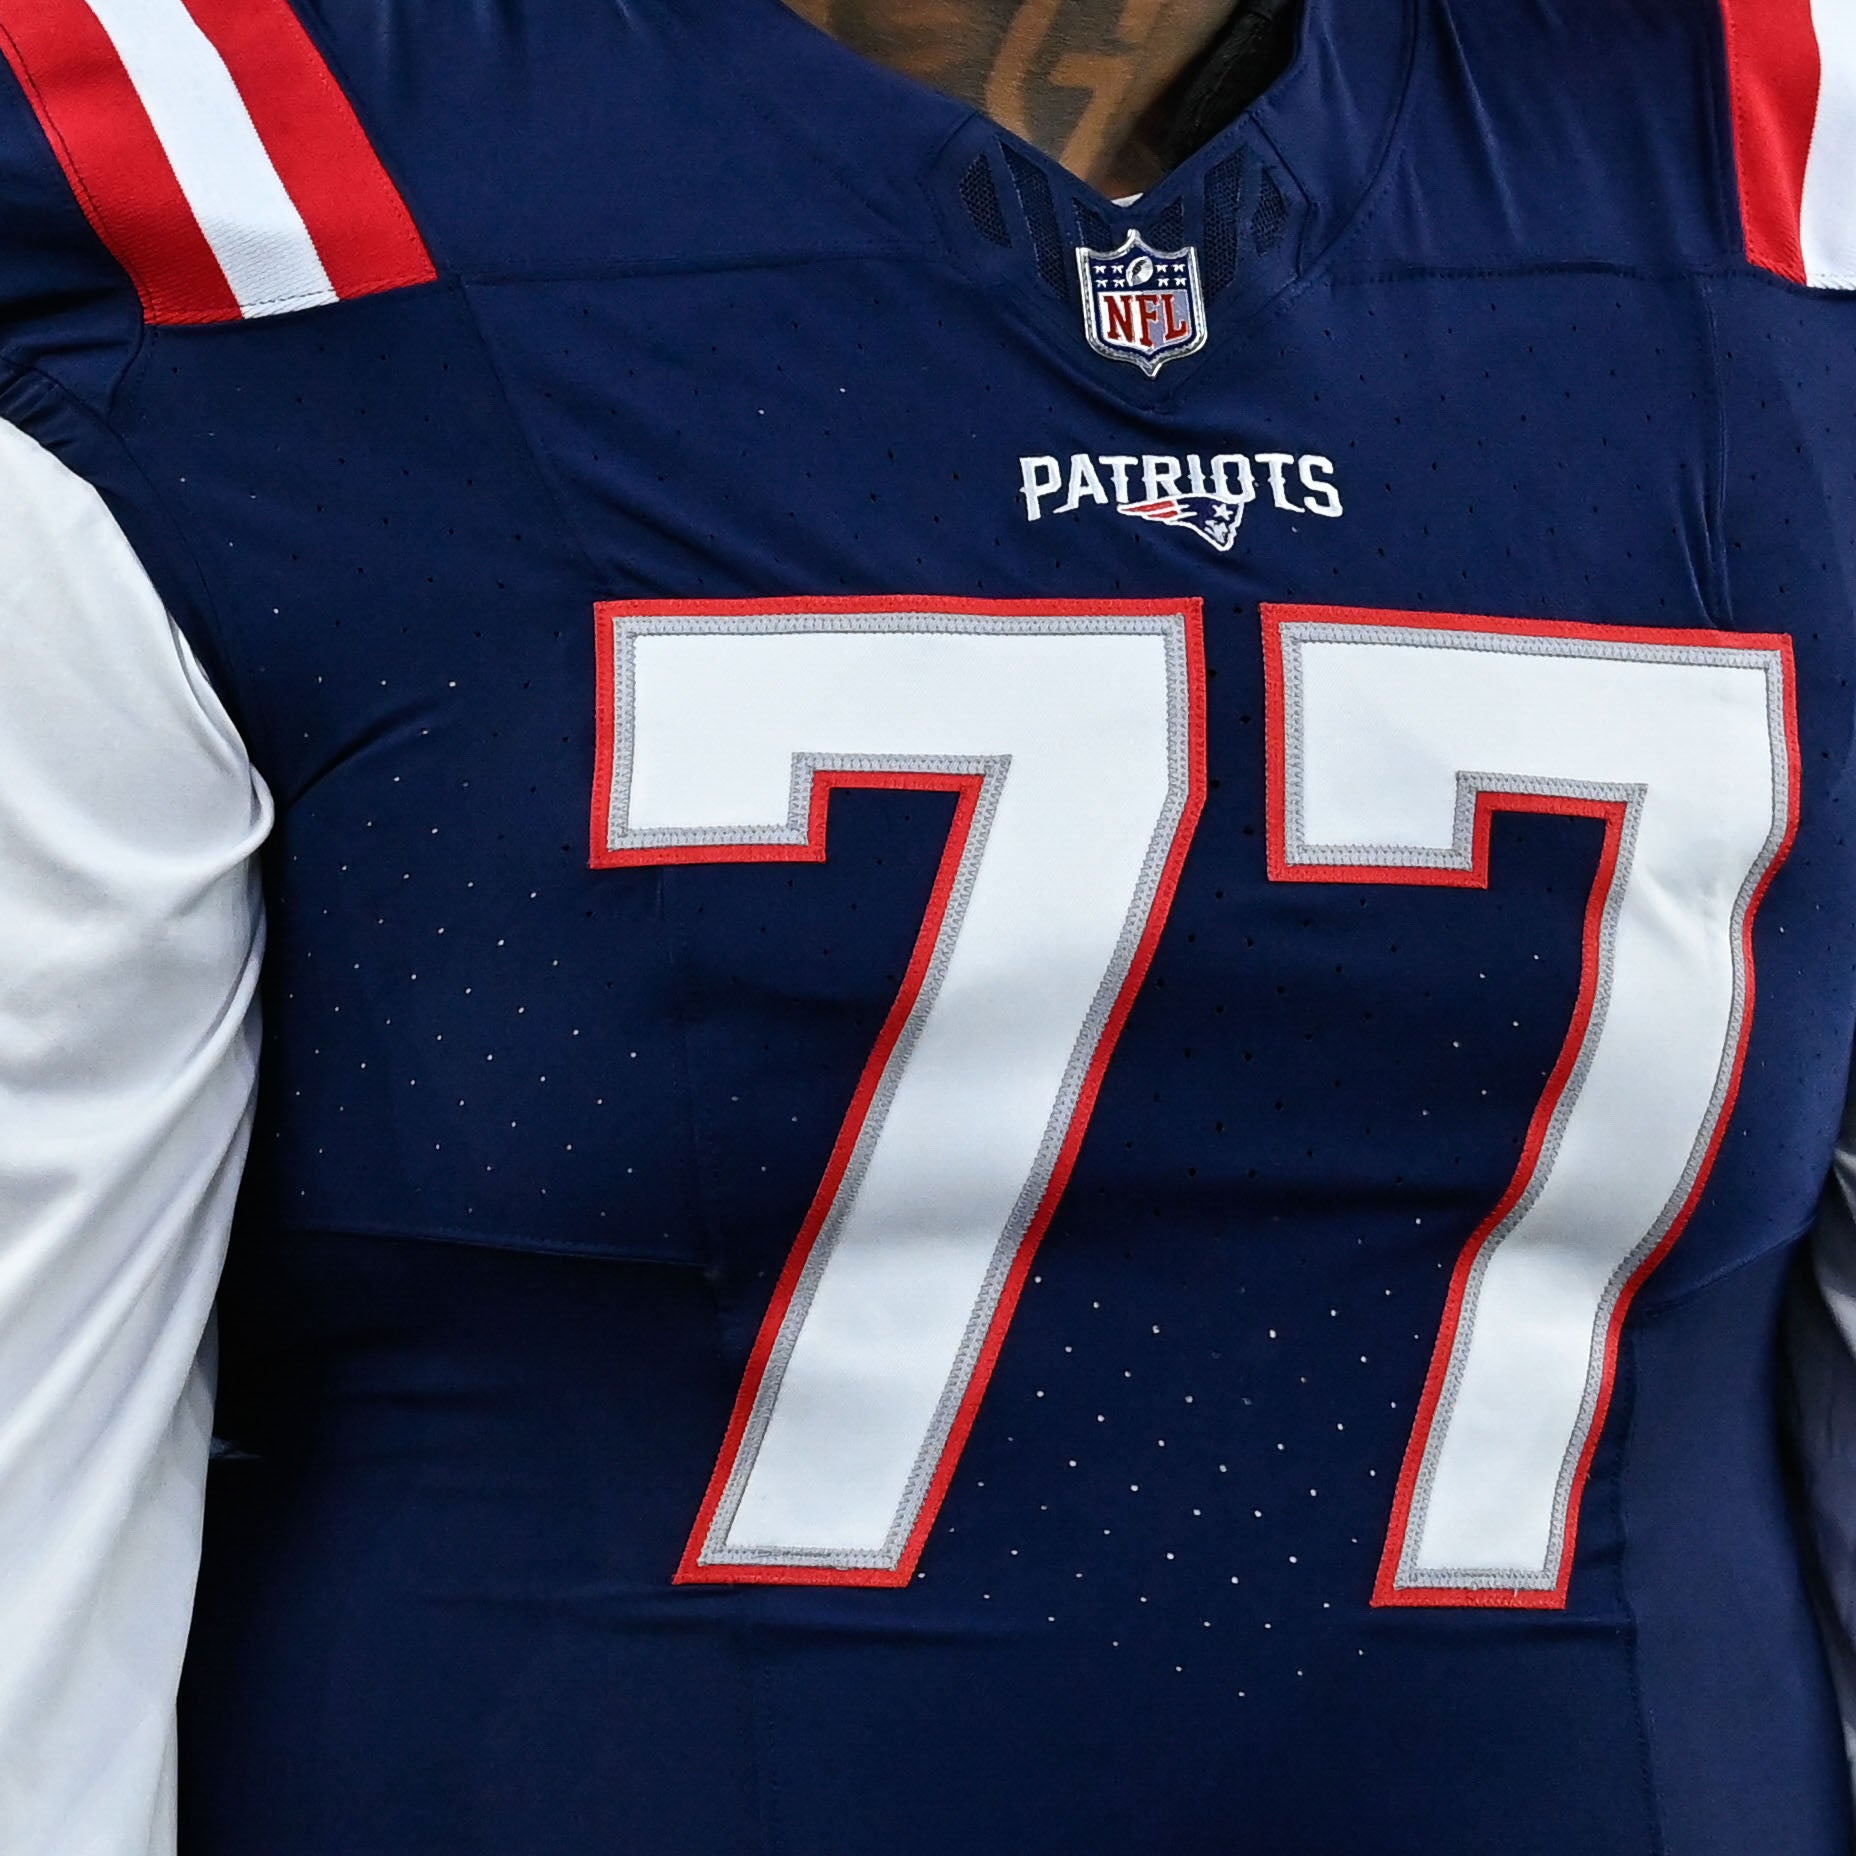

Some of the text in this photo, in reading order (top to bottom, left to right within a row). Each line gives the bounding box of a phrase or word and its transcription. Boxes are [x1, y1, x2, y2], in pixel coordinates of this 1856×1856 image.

[1103, 293, 1189, 347] NFL
[1019, 454, 1343, 522] PATRIOTS
[587, 595, 1802, 1608] 77
